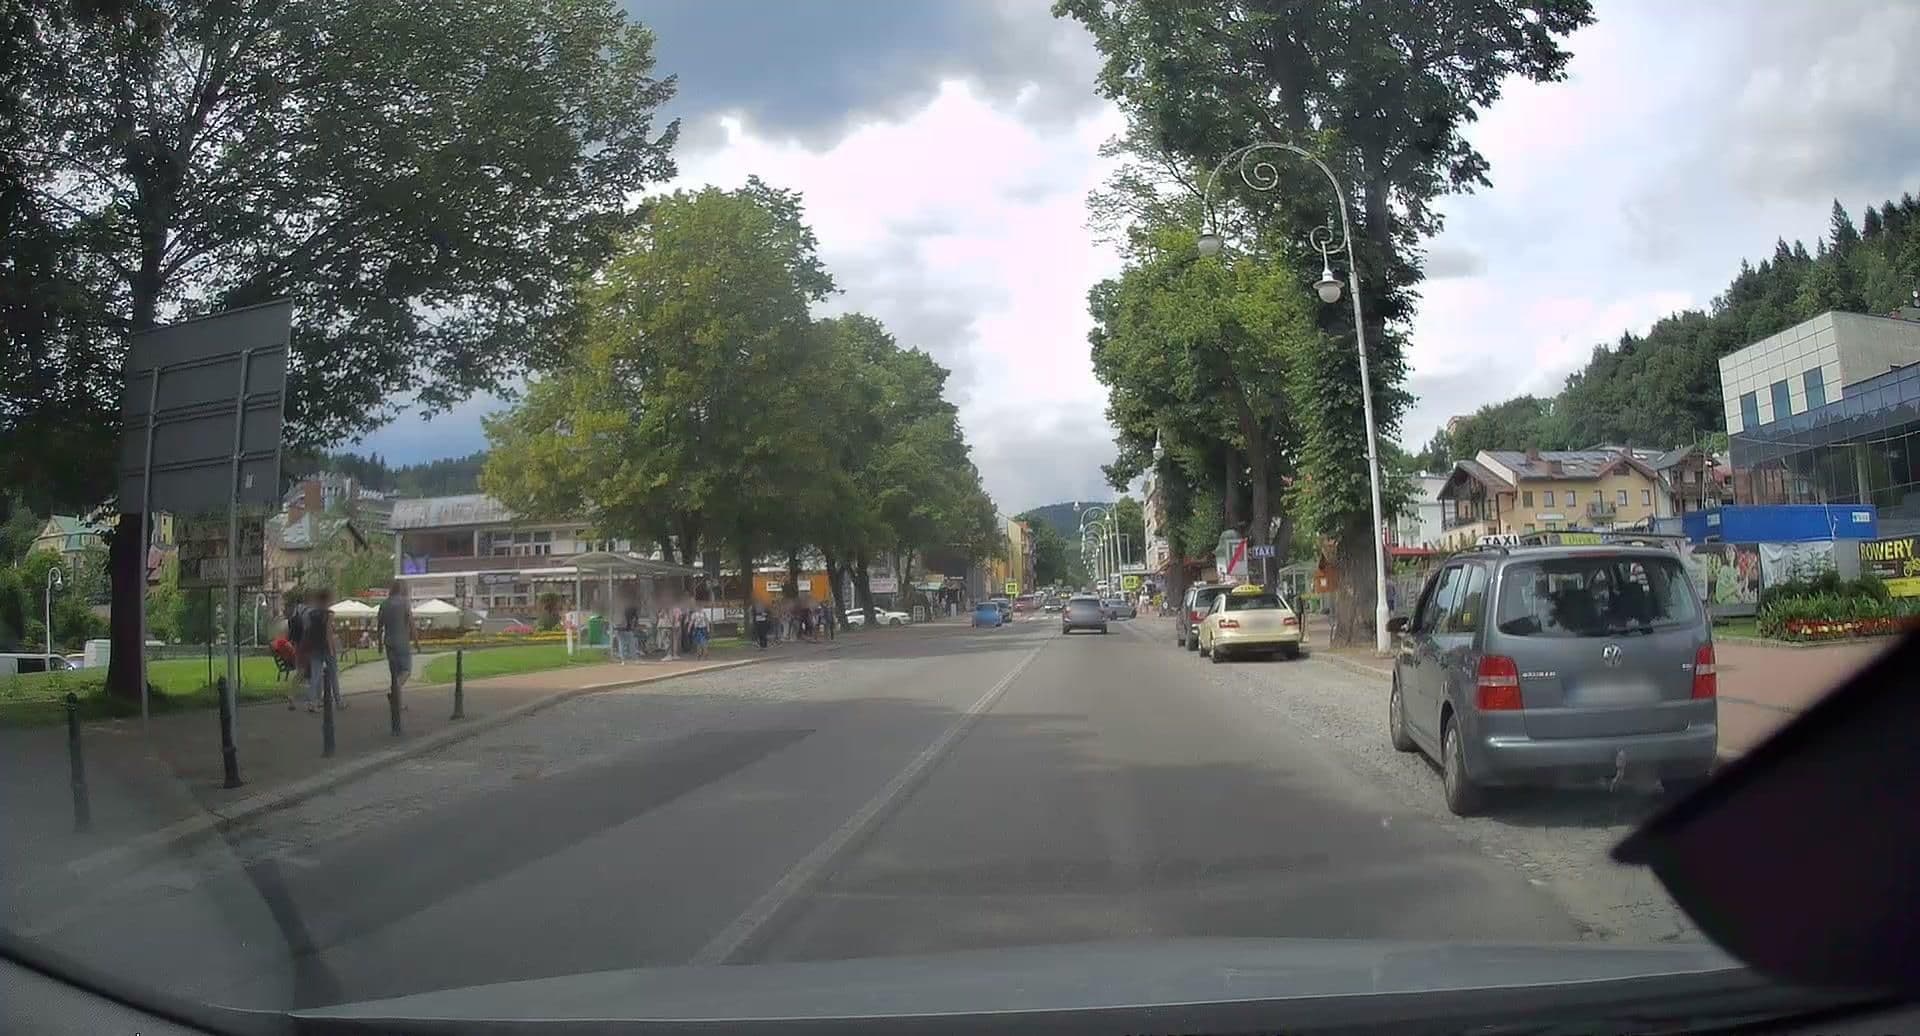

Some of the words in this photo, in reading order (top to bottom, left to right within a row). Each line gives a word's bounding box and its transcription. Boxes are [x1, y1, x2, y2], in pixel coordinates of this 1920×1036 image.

[1483, 536, 1517, 545] TAXI
[1254, 545, 1275, 556] TAXI
[1860, 539, 1913, 560] ROWERY
